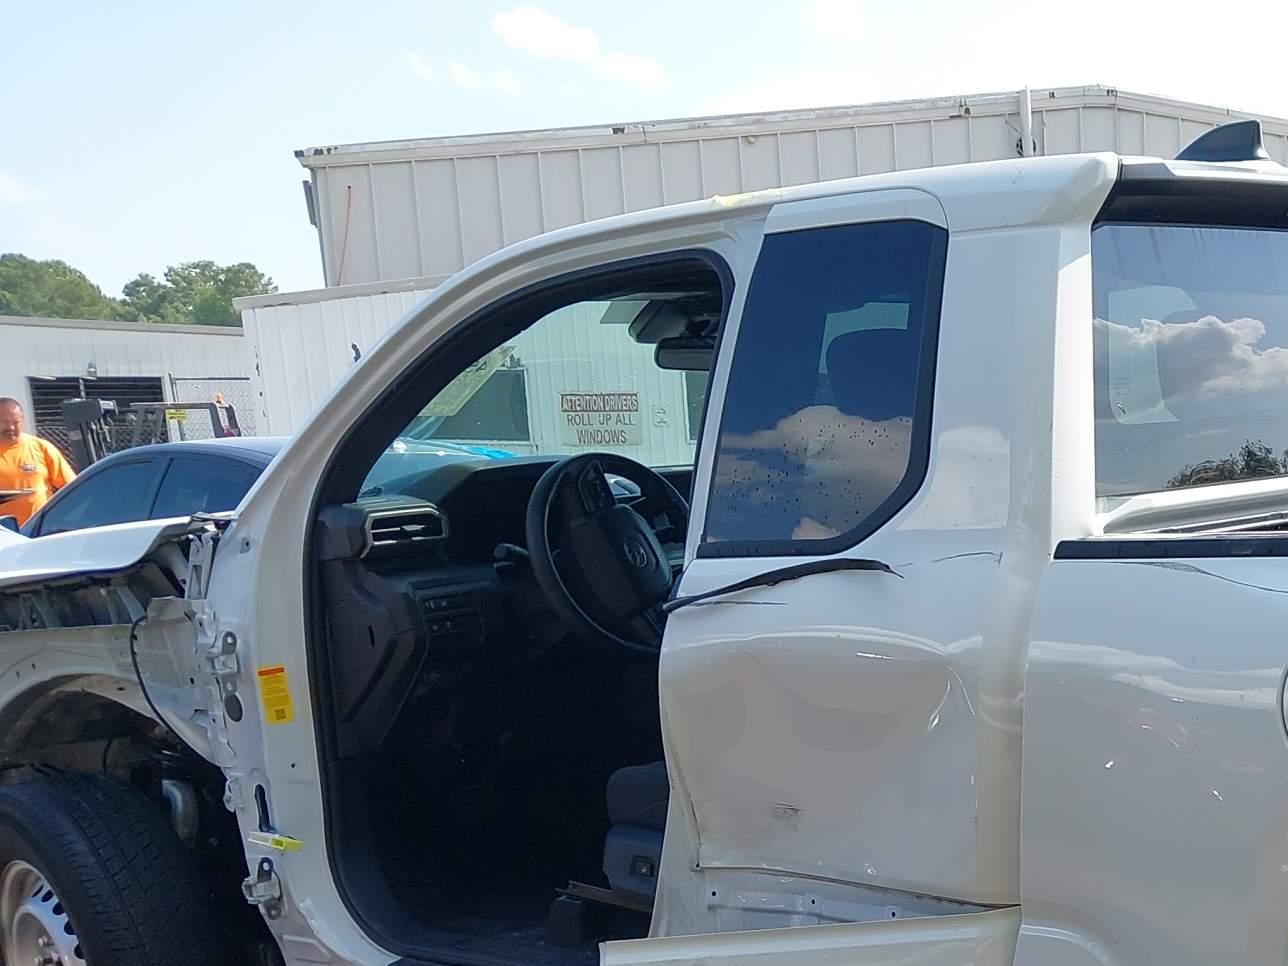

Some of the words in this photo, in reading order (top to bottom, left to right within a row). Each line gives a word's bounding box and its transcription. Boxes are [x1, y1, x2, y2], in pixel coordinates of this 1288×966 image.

[562, 395, 603, 410] ATTENTION
[605, 395, 638, 410] DRIVERS
[567, 413, 593, 426] ROLL
[599, 414, 612, 426] UP
[615, 413, 636, 426] ALL
[576, 429, 627, 444] WINDOWS
